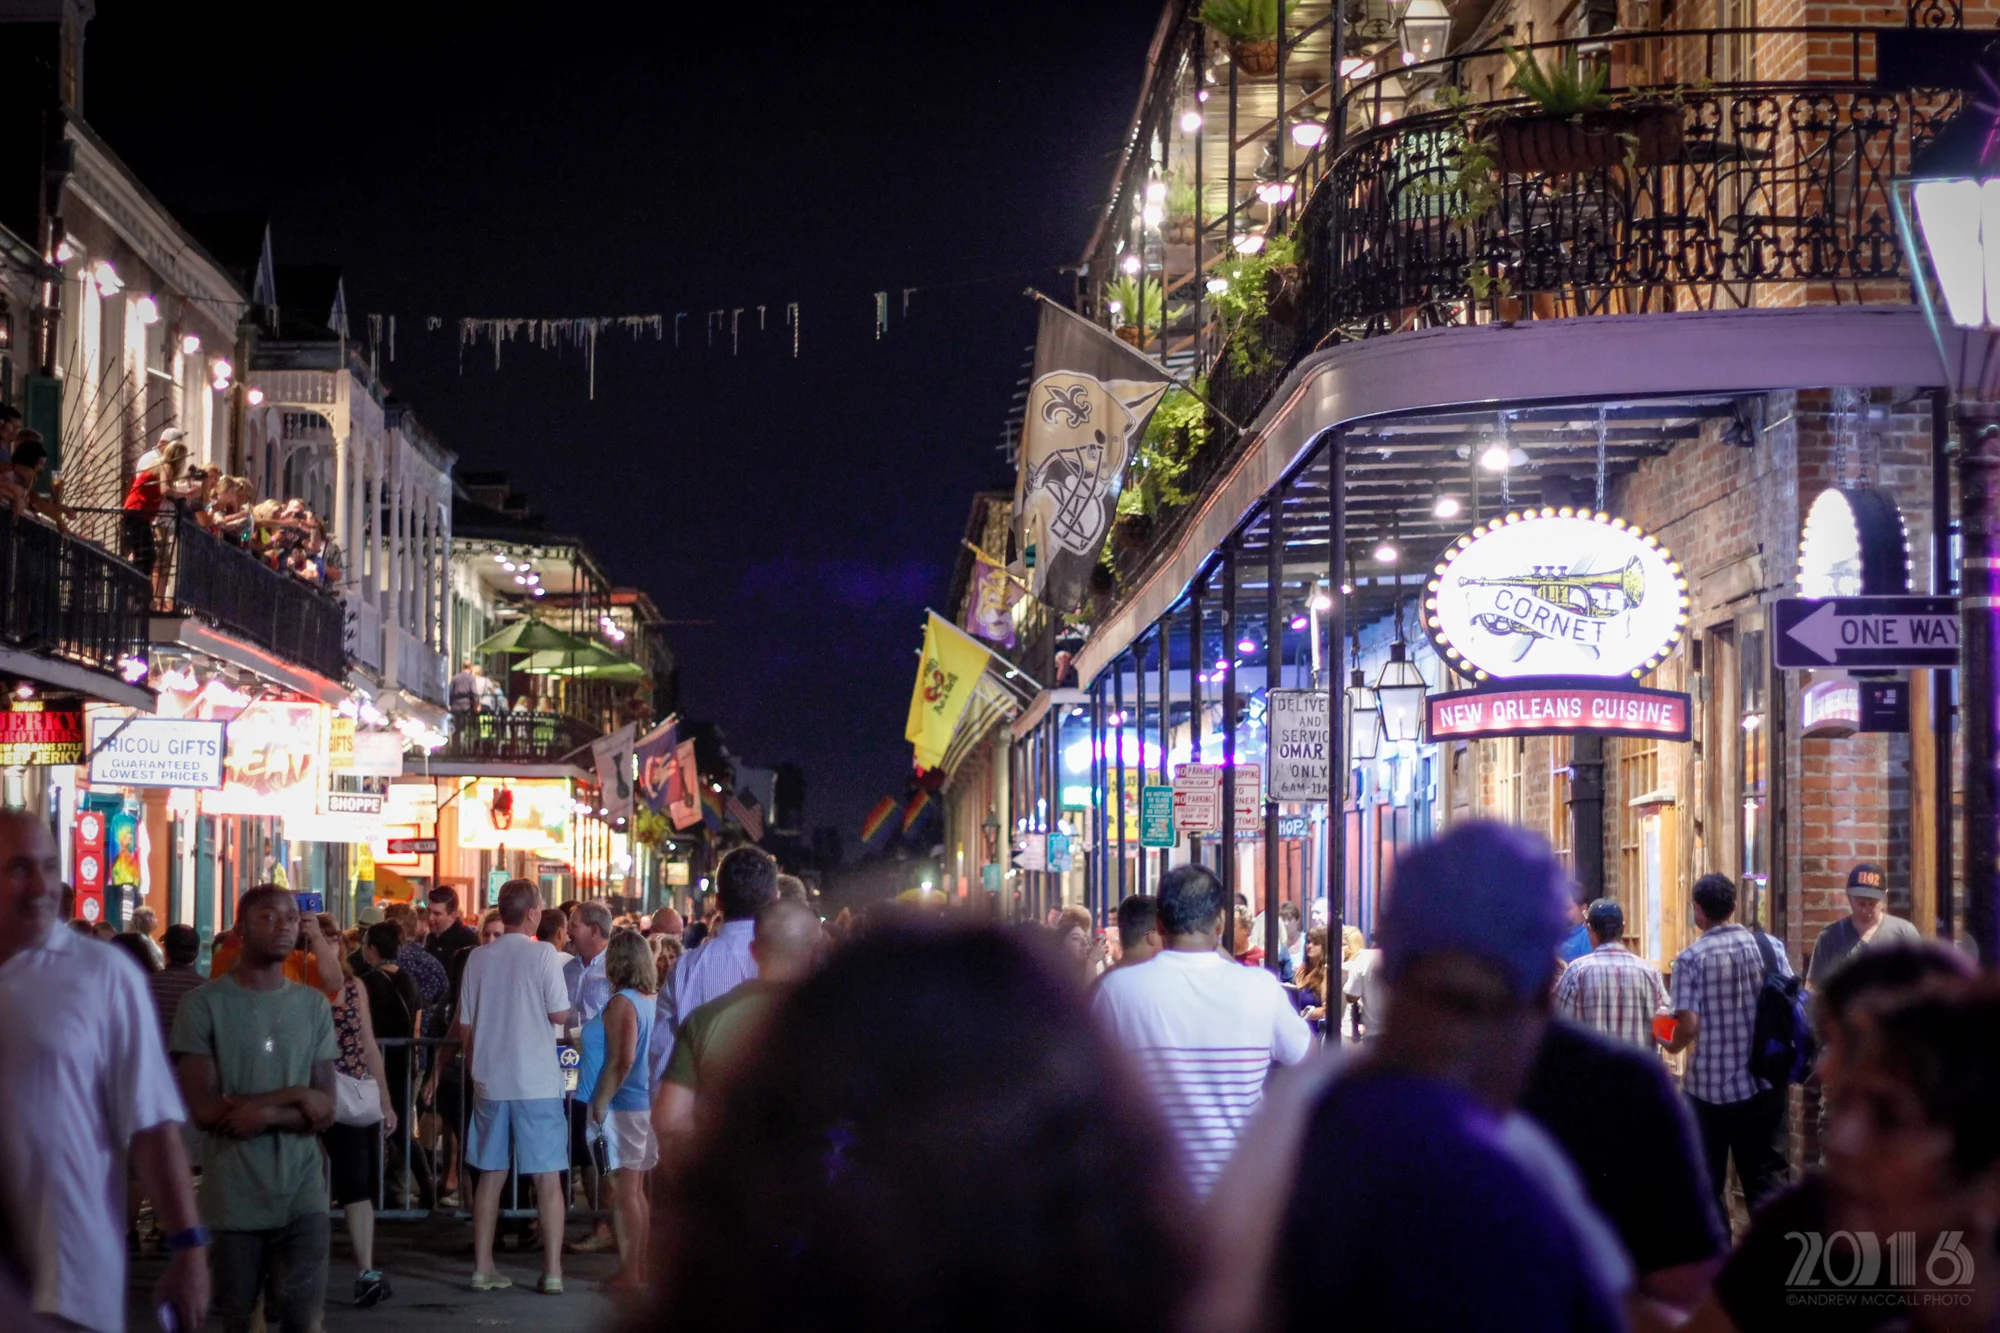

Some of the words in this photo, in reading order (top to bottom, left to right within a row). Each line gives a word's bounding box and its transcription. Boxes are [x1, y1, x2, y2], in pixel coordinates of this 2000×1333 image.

[1495, 589, 1607, 642] CORNET
[1841, 619, 1898, 645] ONE
[1910, 619, 1960, 645] WAY
[1278, 699, 1329, 712] DELIVE
[1440, 703, 1482, 728] NEW
[1492, 698, 1582, 722] ORLEANS
[1592, 698, 1672, 725] CUISINE
[1299, 716, 1321, 727] AND
[1282, 730, 1329, 743] SERVIC
[168, 739, 216, 756] GIFTS
[33, 752, 80, 765] JERKY
[112, 759, 200, 770] GUARANTEED
[102, 769, 155, 779] LOWEST
[161, 771, 208, 781] PRICES
[1188, 767, 1213, 775] PARKING
[1235, 771, 1259, 779] TOPPING
[1291, 765, 1328, 778] ONLY
[1281, 782, 1328, 794] 6AM-11A
[330, 796, 379, 812] SHOPPE
[1175, 796, 1185, 804] NO
[1278, 819, 1304, 836] HOP
